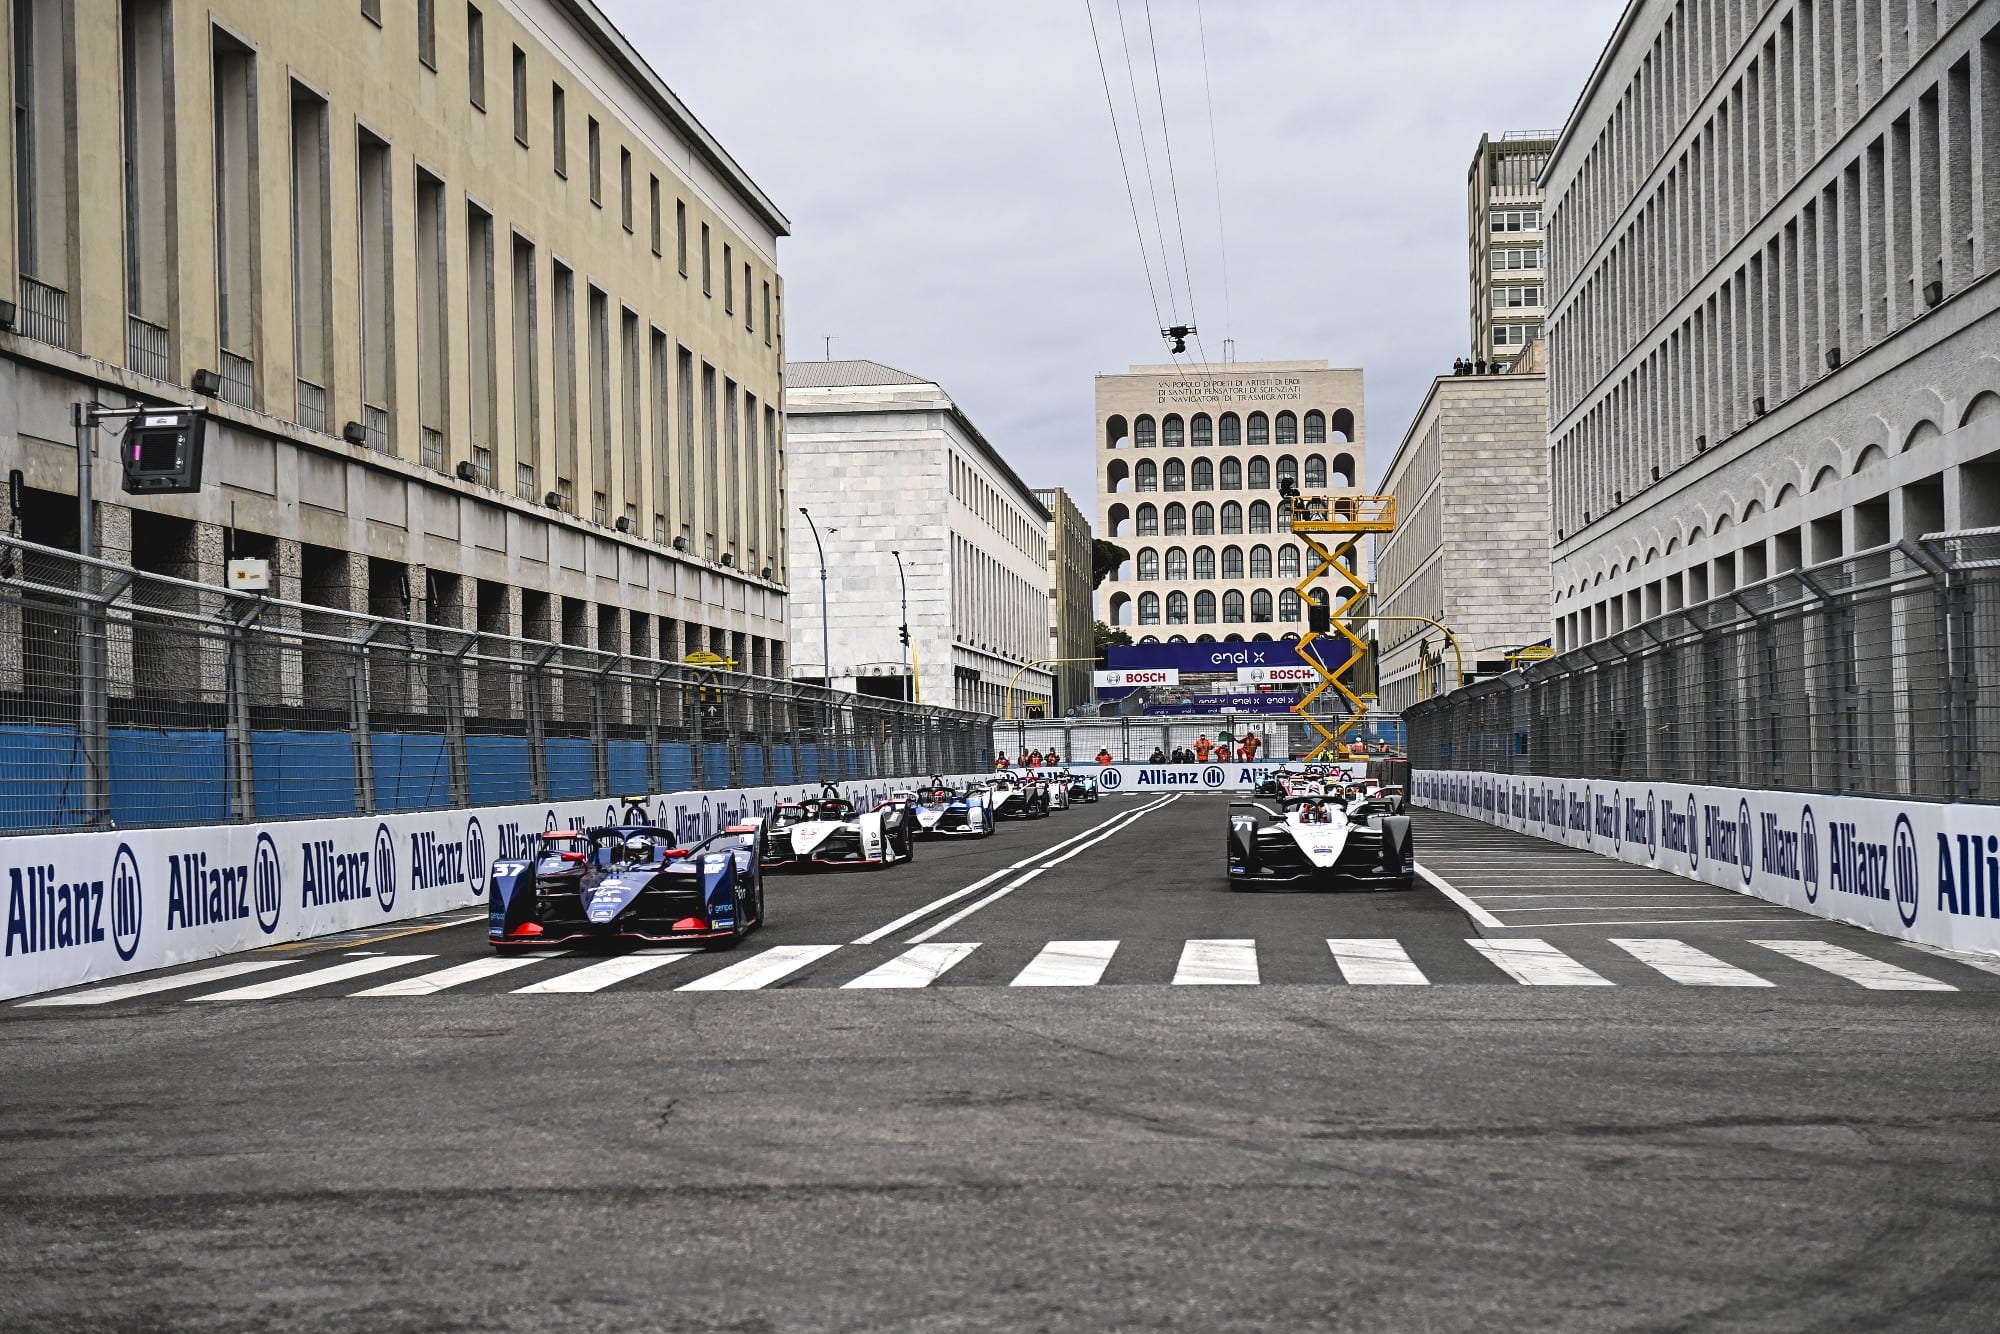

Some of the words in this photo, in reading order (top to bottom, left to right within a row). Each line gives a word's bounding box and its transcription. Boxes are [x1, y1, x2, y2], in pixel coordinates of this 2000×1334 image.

[1158, 396, 1166, 404] DI
[1171, 395, 1220, 403] NAVIGATORI
[1224, 394, 1232, 402] DI
[1237, 393, 1301, 401] TRASMIGRATORI
[1168, 388, 1192, 396] SANTI
[1204, 387, 1247, 395] PENSATORI
[1249, 386, 1257, 394] DI
[1259, 385, 1301, 394] SCIENZIATI
[1172, 381, 1200, 389] POPOLO
[1203, 380, 1211, 388] DI
[1212, 380, 1233, 388] POETI
[1235, 379, 1243, 387] DI
[1245, 378, 1273, 387] ARTISTI
[1275, 378, 1283, 386] DI
[1284, 378, 1301, 386] EROI
[1211, 649, 1249, 664] enel
[1269, 669, 1312, 680] BOSCH
[1125, 672, 1167, 683] BOSCH
[1232, 697, 1252, 705] enel
[1266, 696, 1287, 704] enel
[1137, 769, 1199, 785] Allianz
[674, 804, 702, 845] Allianz
[1595, 793, 1614, 839] Allianz
[1625, 797, 1647, 845] Allianz
[1661, 799, 1688, 854] Allianz
[1704, 804, 1738, 866] Allianz
[410, 830, 465, 891] Allianz
[1760, 811, 1801, 881] Allianz
[1829, 821, 1891, 901] Allianz
[167, 851, 250, 931] Allianz
[301, 839, 372, 909] Allianz
[493, 863, 526, 878] 37
[5, 863, 105, 957] Allianz
